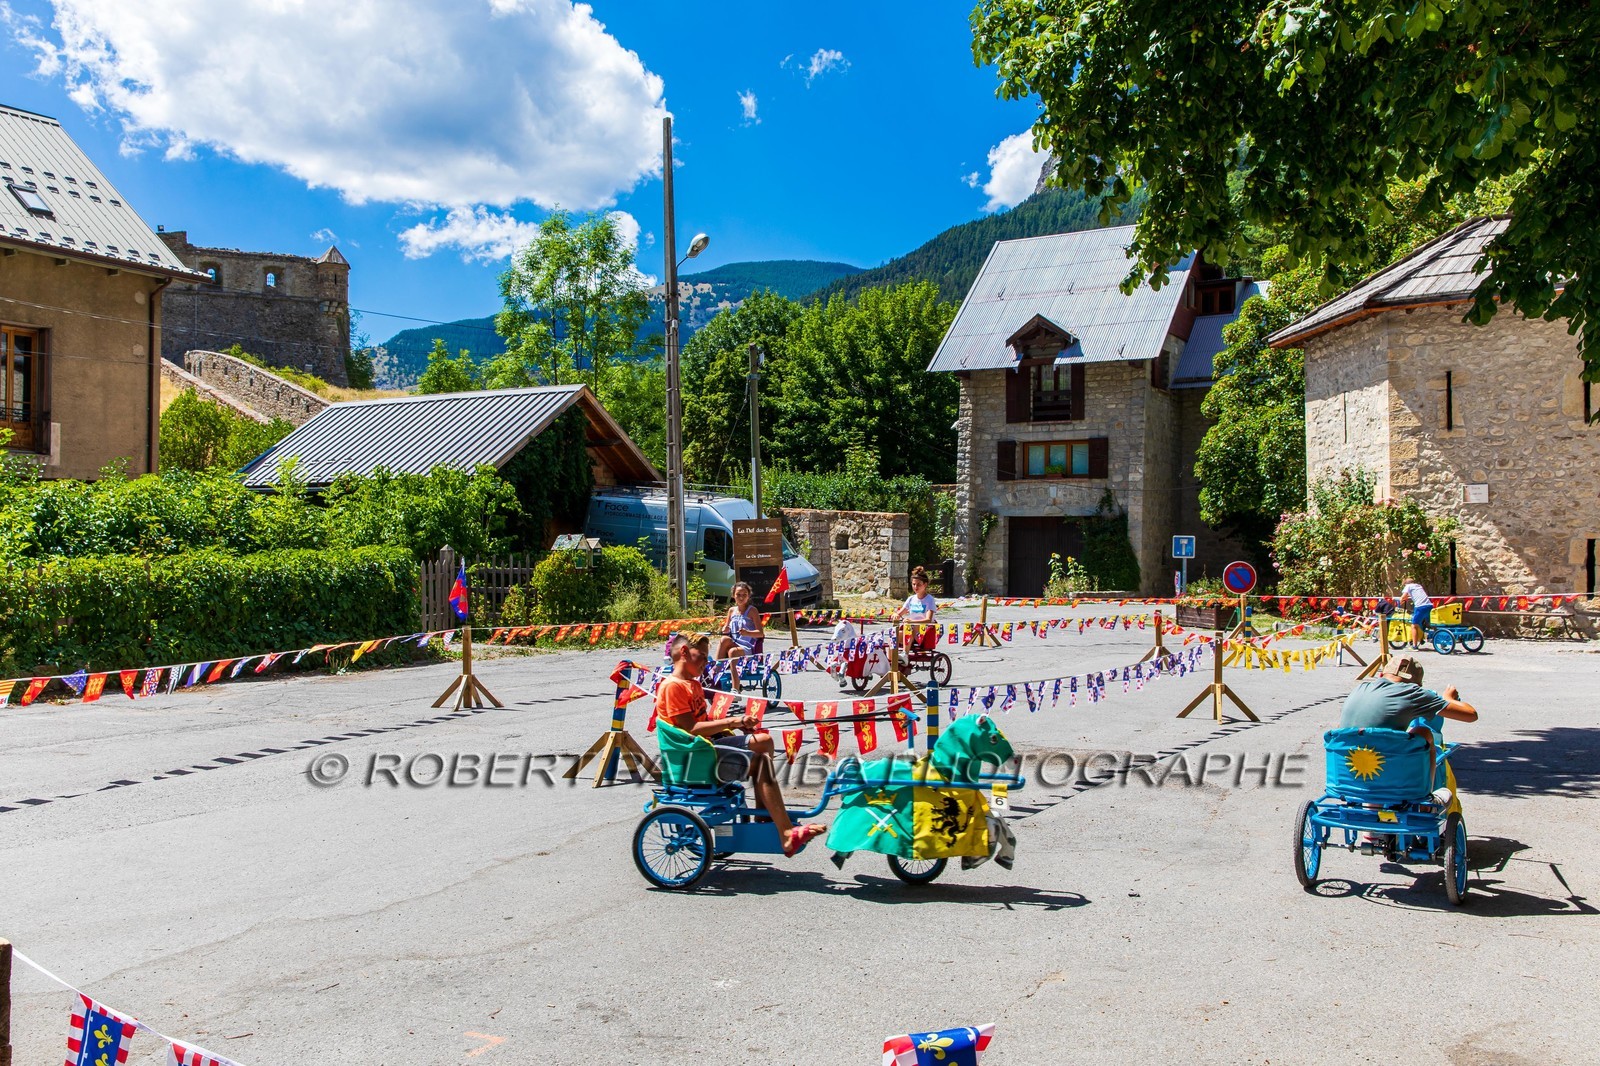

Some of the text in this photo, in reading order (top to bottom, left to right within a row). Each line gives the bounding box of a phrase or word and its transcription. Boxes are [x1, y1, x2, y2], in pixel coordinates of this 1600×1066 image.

[596, 500, 629, 511] T Face
[995, 797, 1004, 806] 6
